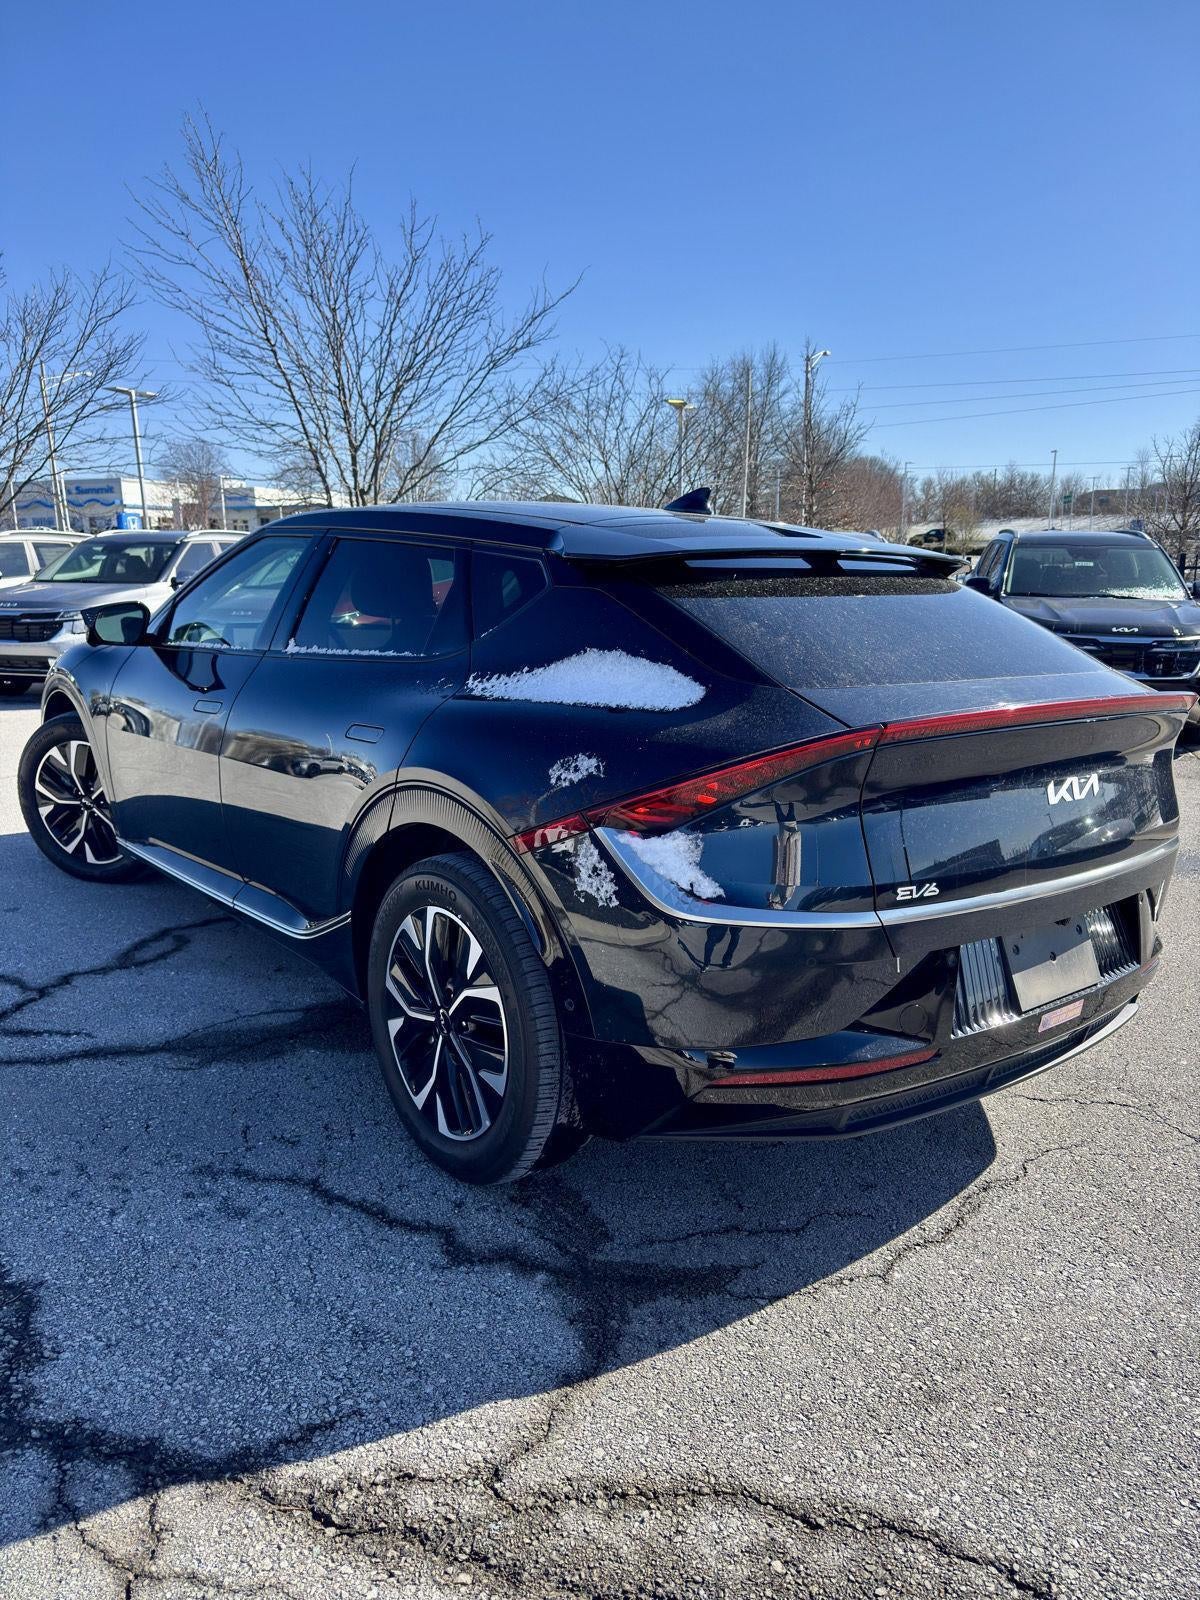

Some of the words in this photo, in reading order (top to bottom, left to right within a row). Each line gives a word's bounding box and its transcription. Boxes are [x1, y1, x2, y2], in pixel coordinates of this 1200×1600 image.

[75, 485, 114, 495] Summit
[1047, 773, 1099, 805] KIA
[414, 879, 457, 902] KUMHO
[896, 883, 940, 901] EV6
